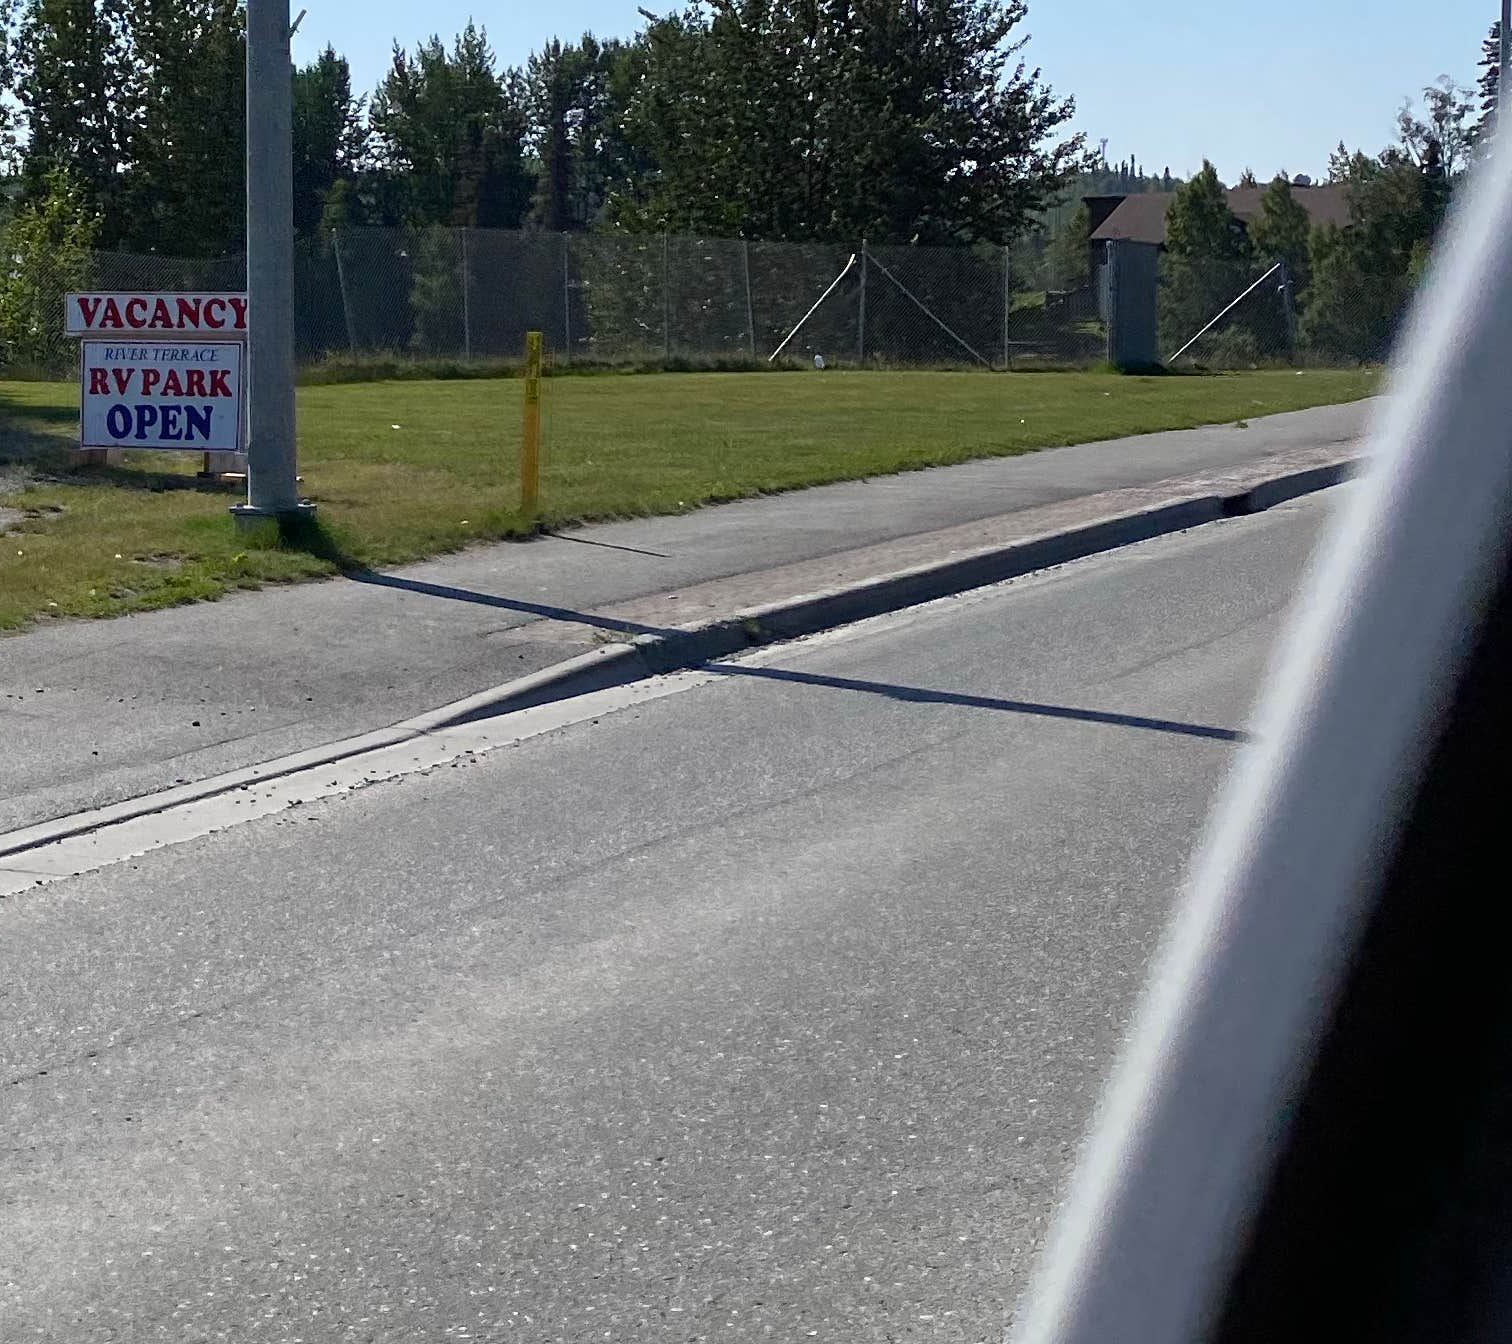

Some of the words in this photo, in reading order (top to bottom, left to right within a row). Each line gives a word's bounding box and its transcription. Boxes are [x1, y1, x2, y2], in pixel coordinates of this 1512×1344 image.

[77, 298, 247, 329] VACANCY
[104, 347, 148, 361] RIVER
[152, 348, 220, 362] TERRACE
[89, 367, 135, 395] RV
[140, 368, 233, 397] PARK
[106, 404, 214, 441] OPEN
